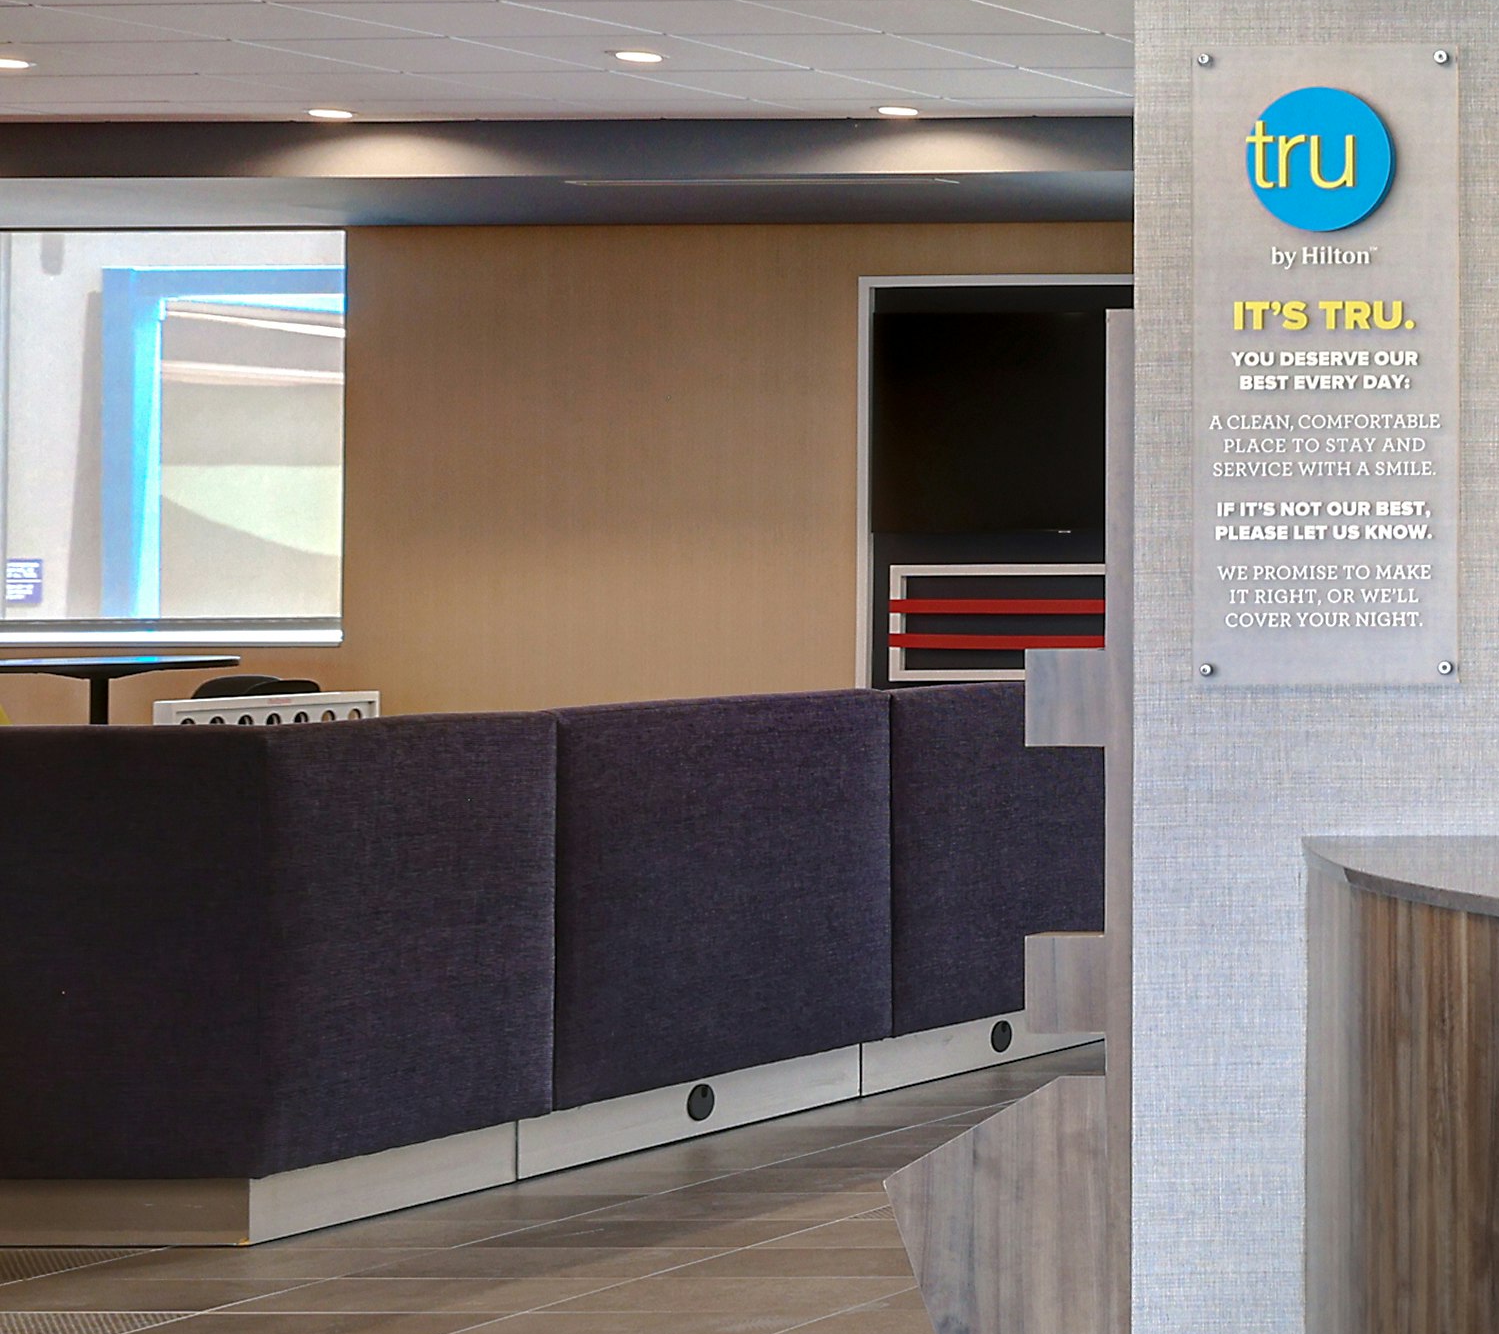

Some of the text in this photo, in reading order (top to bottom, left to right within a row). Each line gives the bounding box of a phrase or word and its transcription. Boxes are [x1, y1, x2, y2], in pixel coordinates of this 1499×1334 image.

[1245, 120, 1355, 188] tru
[1270, 246, 1296, 269] by
[1233, 300, 1416, 330] IT'S TRU.
[1231, 351, 1418, 366] YOU DESERVE OUR
[1239, 375, 1411, 390] BEST EVERY DAY:
[1209, 414, 1441, 432] A CLEAN, COMFORTABLE
[1224, 438, 1425, 453] PLACE TO STAY AND
[1212, 461, 1436, 476] SERVICE WITH A SMILE.
[1217, 501, 1431, 518] IF IT'S NOT OUR BEST,
[1215, 524, 1432, 540] PLEASE LET US KNOW.
[1217, 565, 1431, 580] WE PROMISE TO MAKE
[1229, 588, 1419, 605] IT RIGHT, OR WE'LL
[1225, 612, 1423, 628] COVER YOUR NIGHT.
